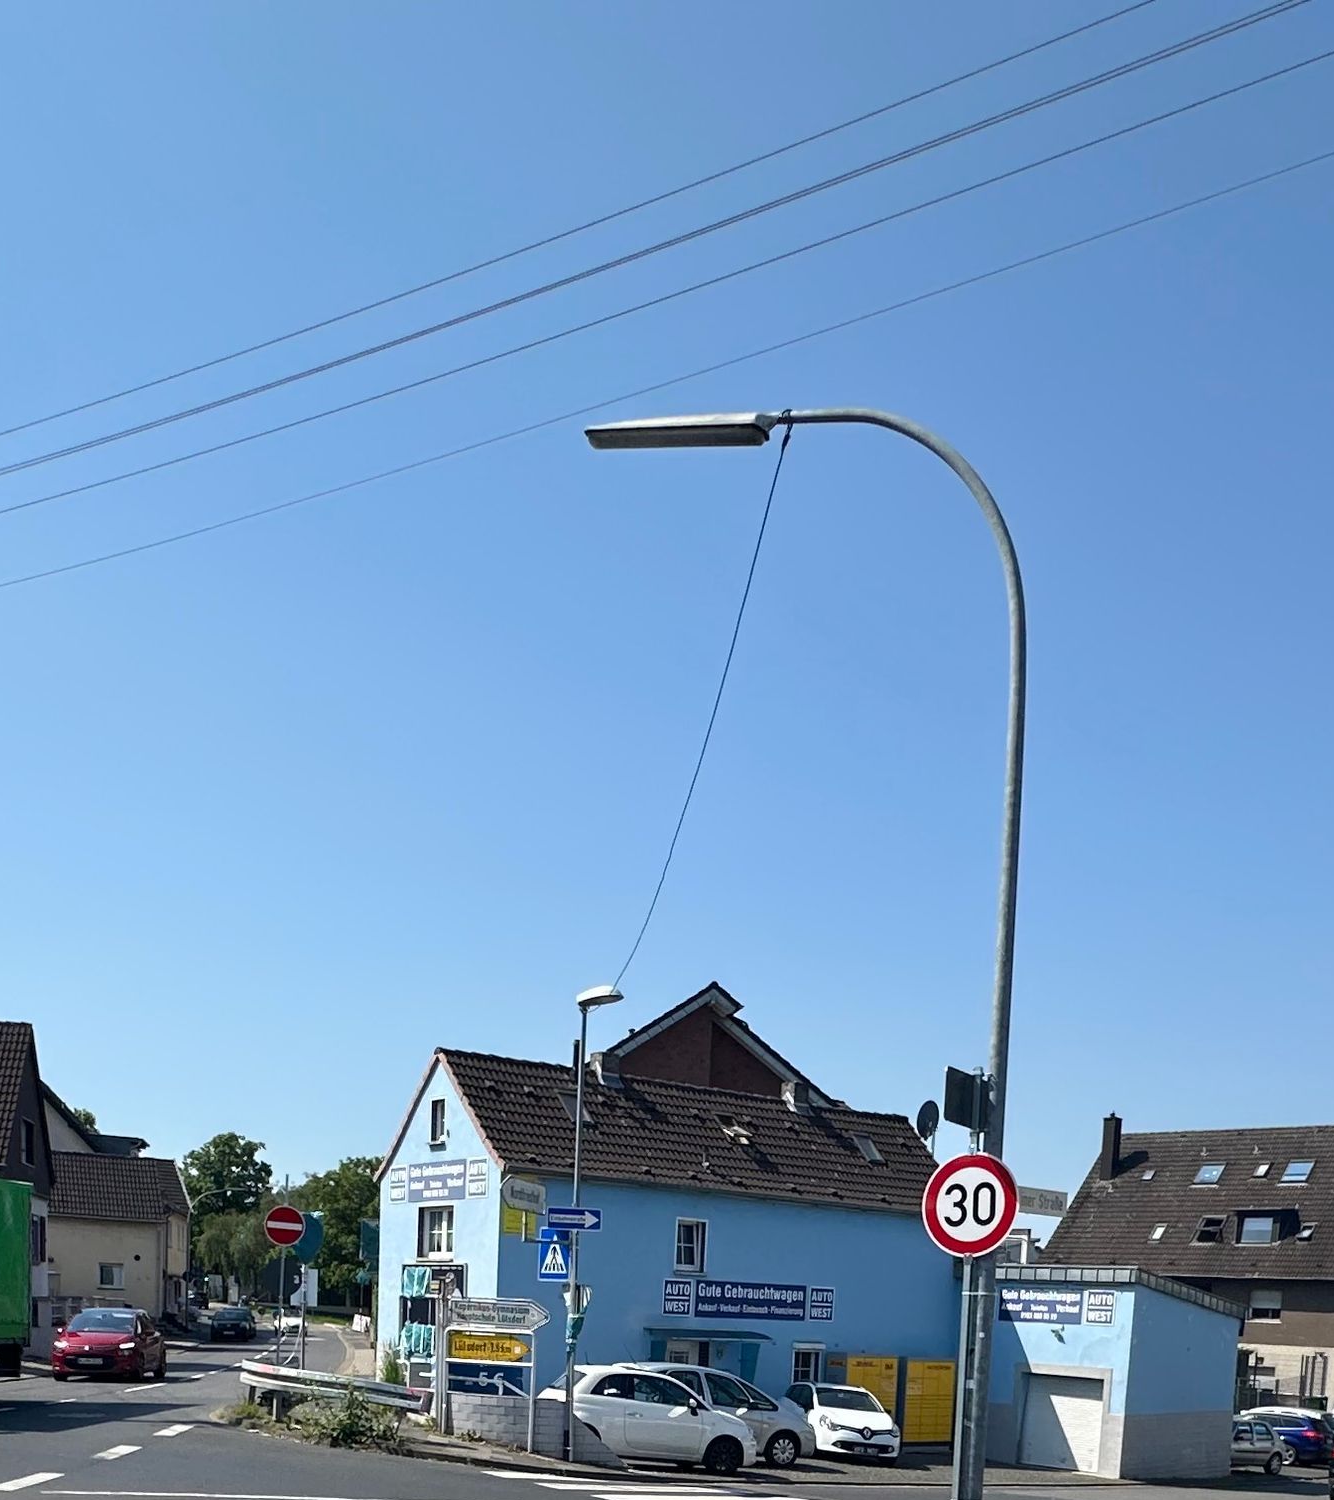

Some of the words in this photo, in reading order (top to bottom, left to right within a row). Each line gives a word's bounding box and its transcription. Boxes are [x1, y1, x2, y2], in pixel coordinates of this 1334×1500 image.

[944, 1182, 996, 1227] 30
[665, 1283, 690, 1296] AUTO
[698, 1282, 722, 1298] Gute
[724, 1284, 804, 1304] Gebrauchtwagen
[811, 1291, 833, 1303] AUTO
[1088, 1294, 1113, 1306] AUTO
[665, 1300, 689, 1313] WEST
[810, 1307, 831, 1318] WEST
[1087, 1311, 1112, 1322] WEST
